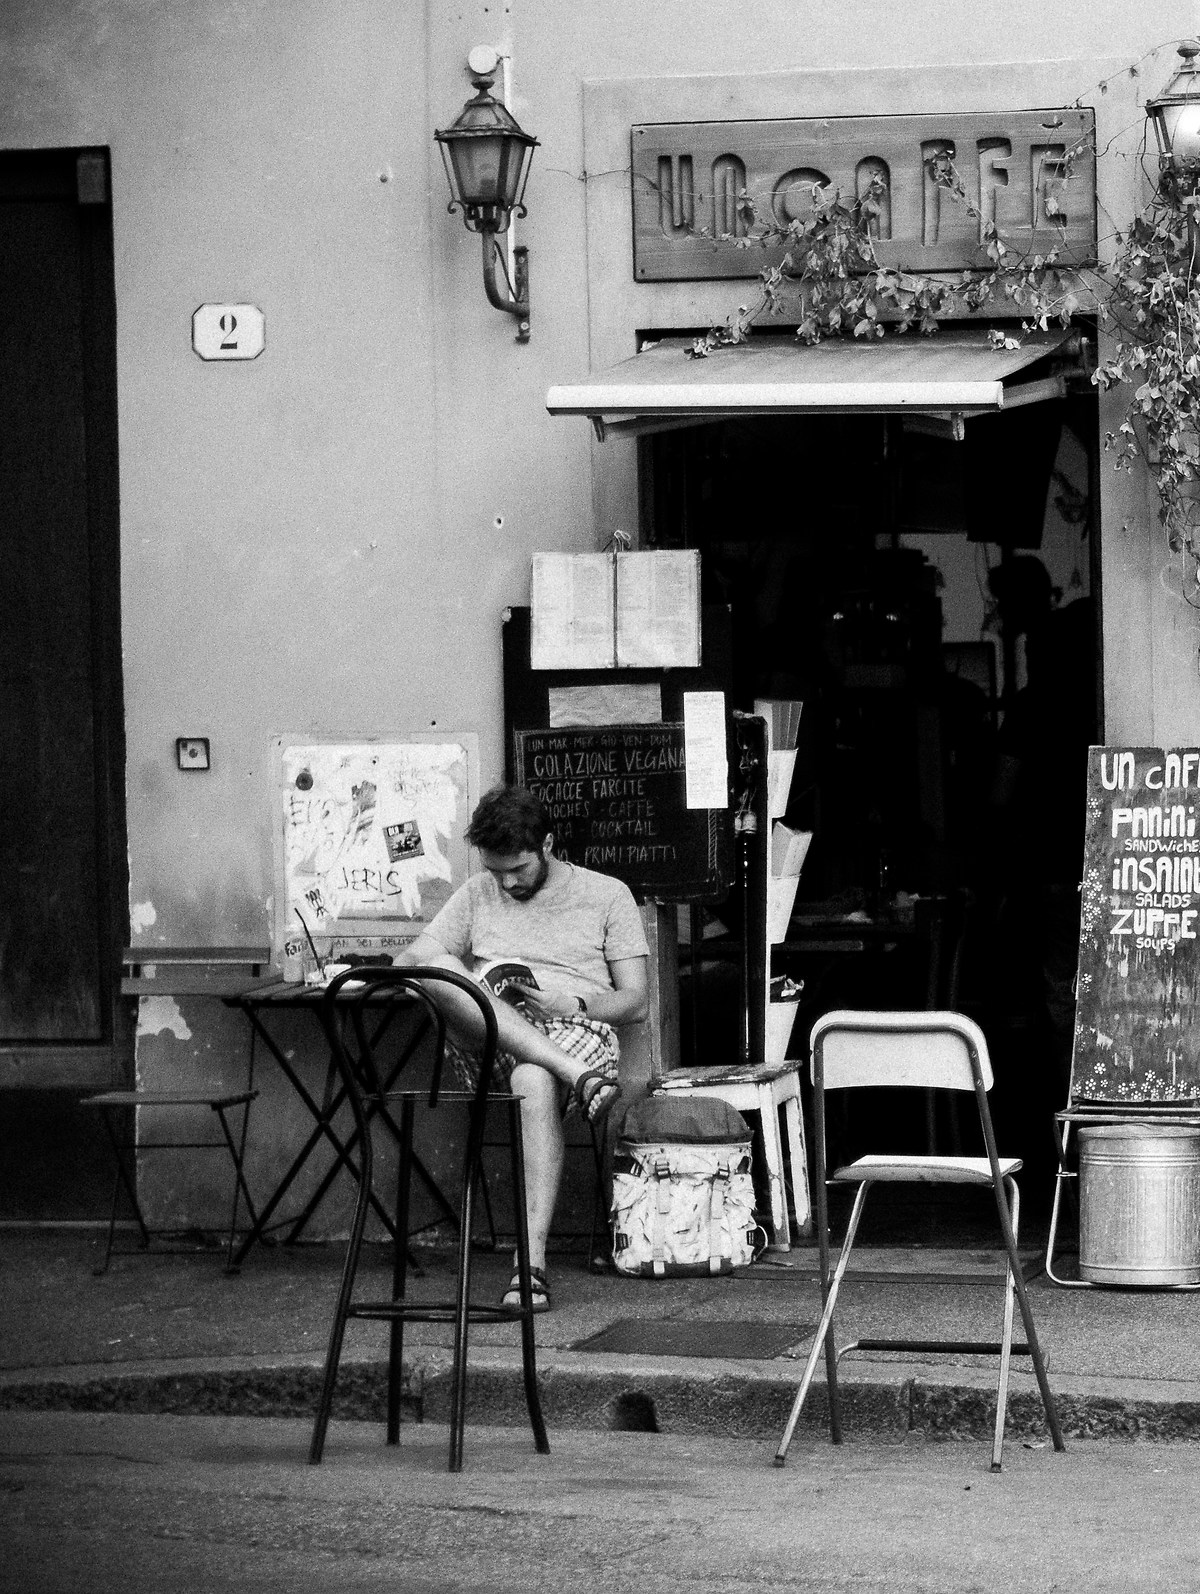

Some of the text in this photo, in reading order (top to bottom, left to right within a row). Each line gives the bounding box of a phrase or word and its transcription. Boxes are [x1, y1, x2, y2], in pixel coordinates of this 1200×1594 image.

[220, 315, 237, 349] 2
[534, 748, 685, 777] COLAZIONE VEGANA
[592, 778, 646, 800] FARCITE
[591, 820, 656, 837] COCKTAIL
[627, 845, 677, 863] PIATTI
[1135, 893, 1191, 908] SALADS
[1109, 909, 1198, 939] ZUPPE
